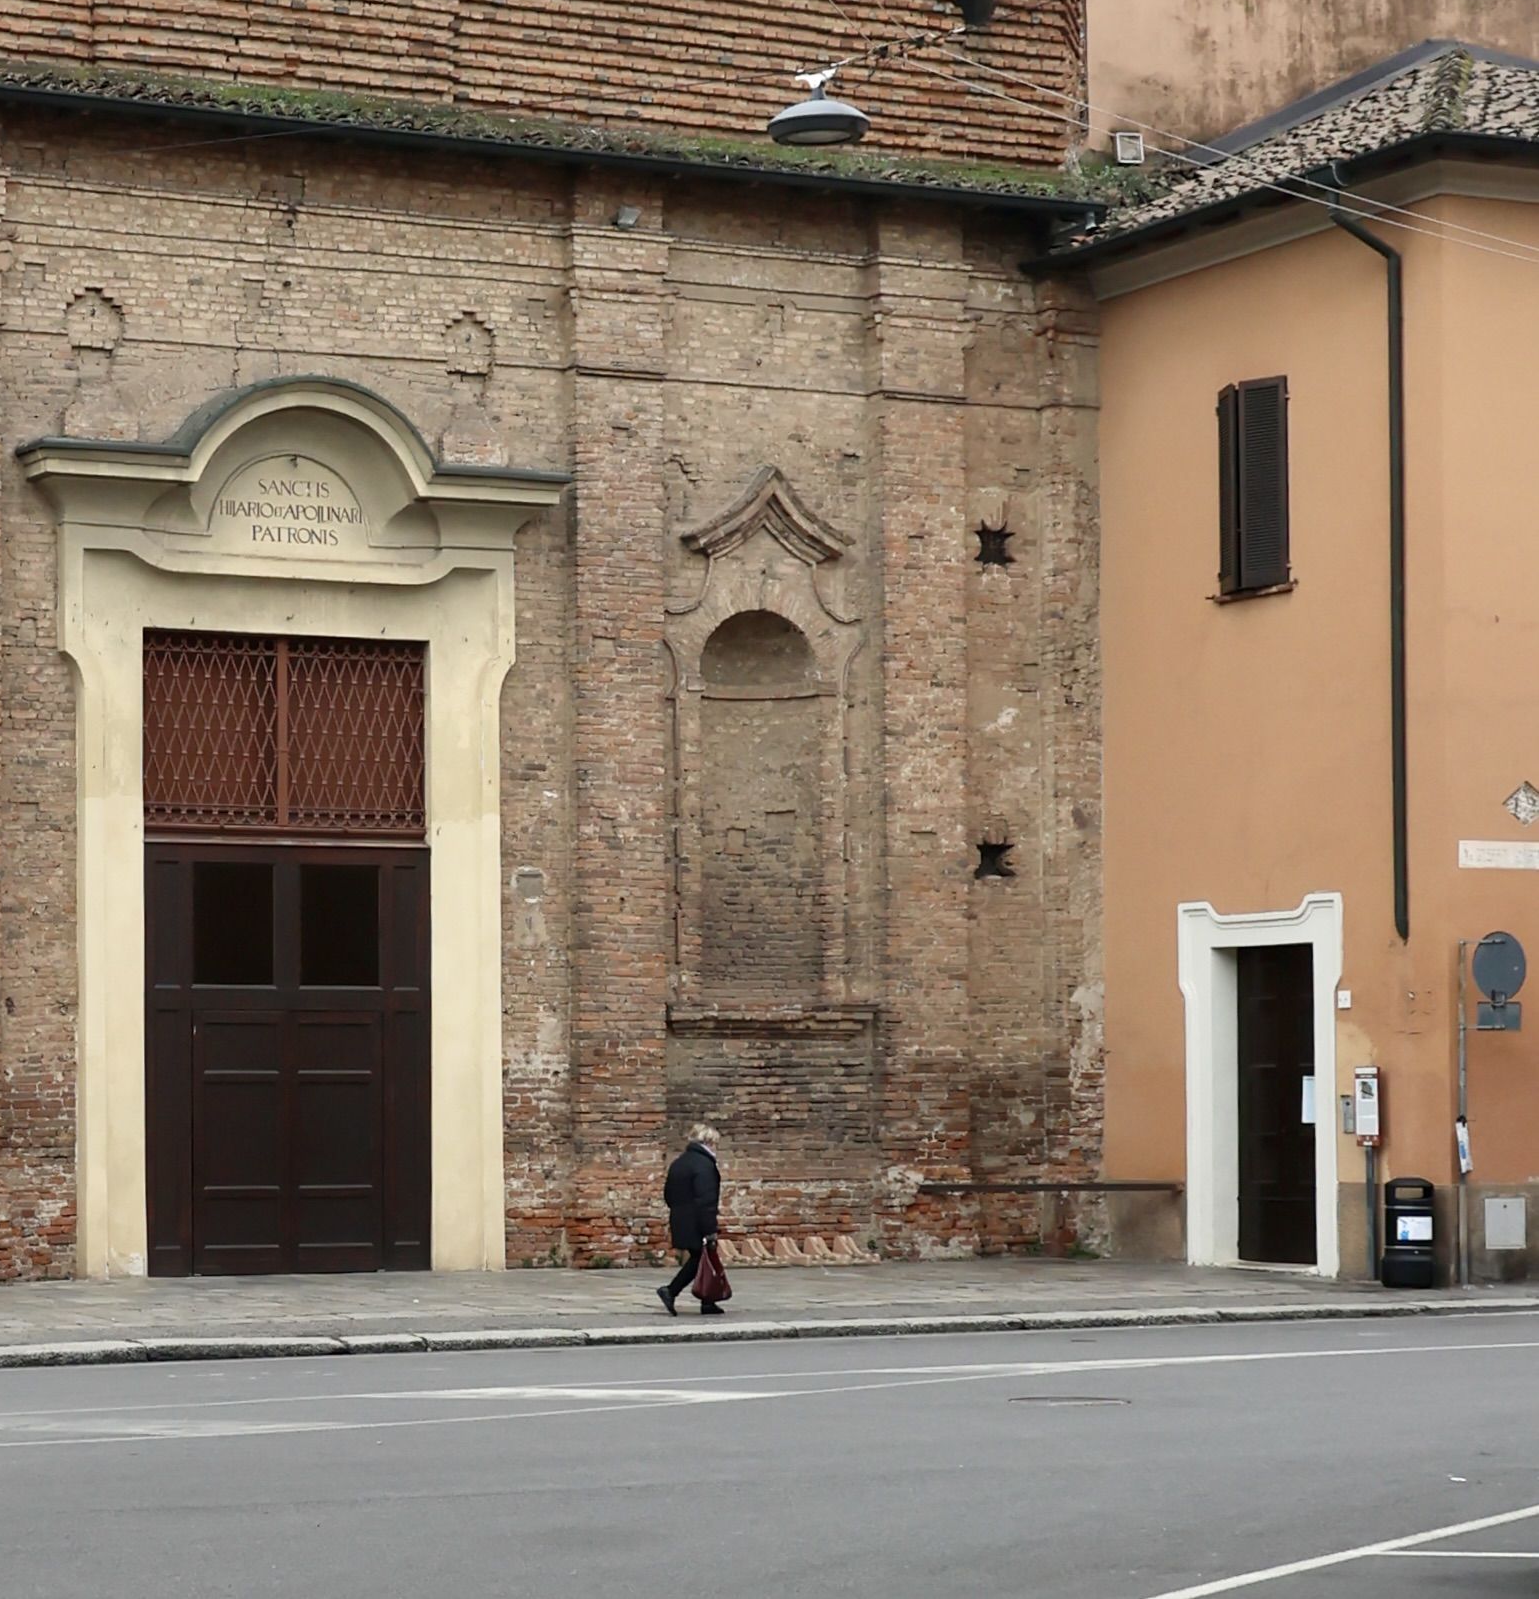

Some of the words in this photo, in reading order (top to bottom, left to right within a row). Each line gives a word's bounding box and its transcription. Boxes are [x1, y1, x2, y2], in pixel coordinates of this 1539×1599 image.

[258, 478, 330, 498] SANCTIS
[219, 498, 274, 519] HILARIO
[251, 524, 339, 547] PATRONIS
